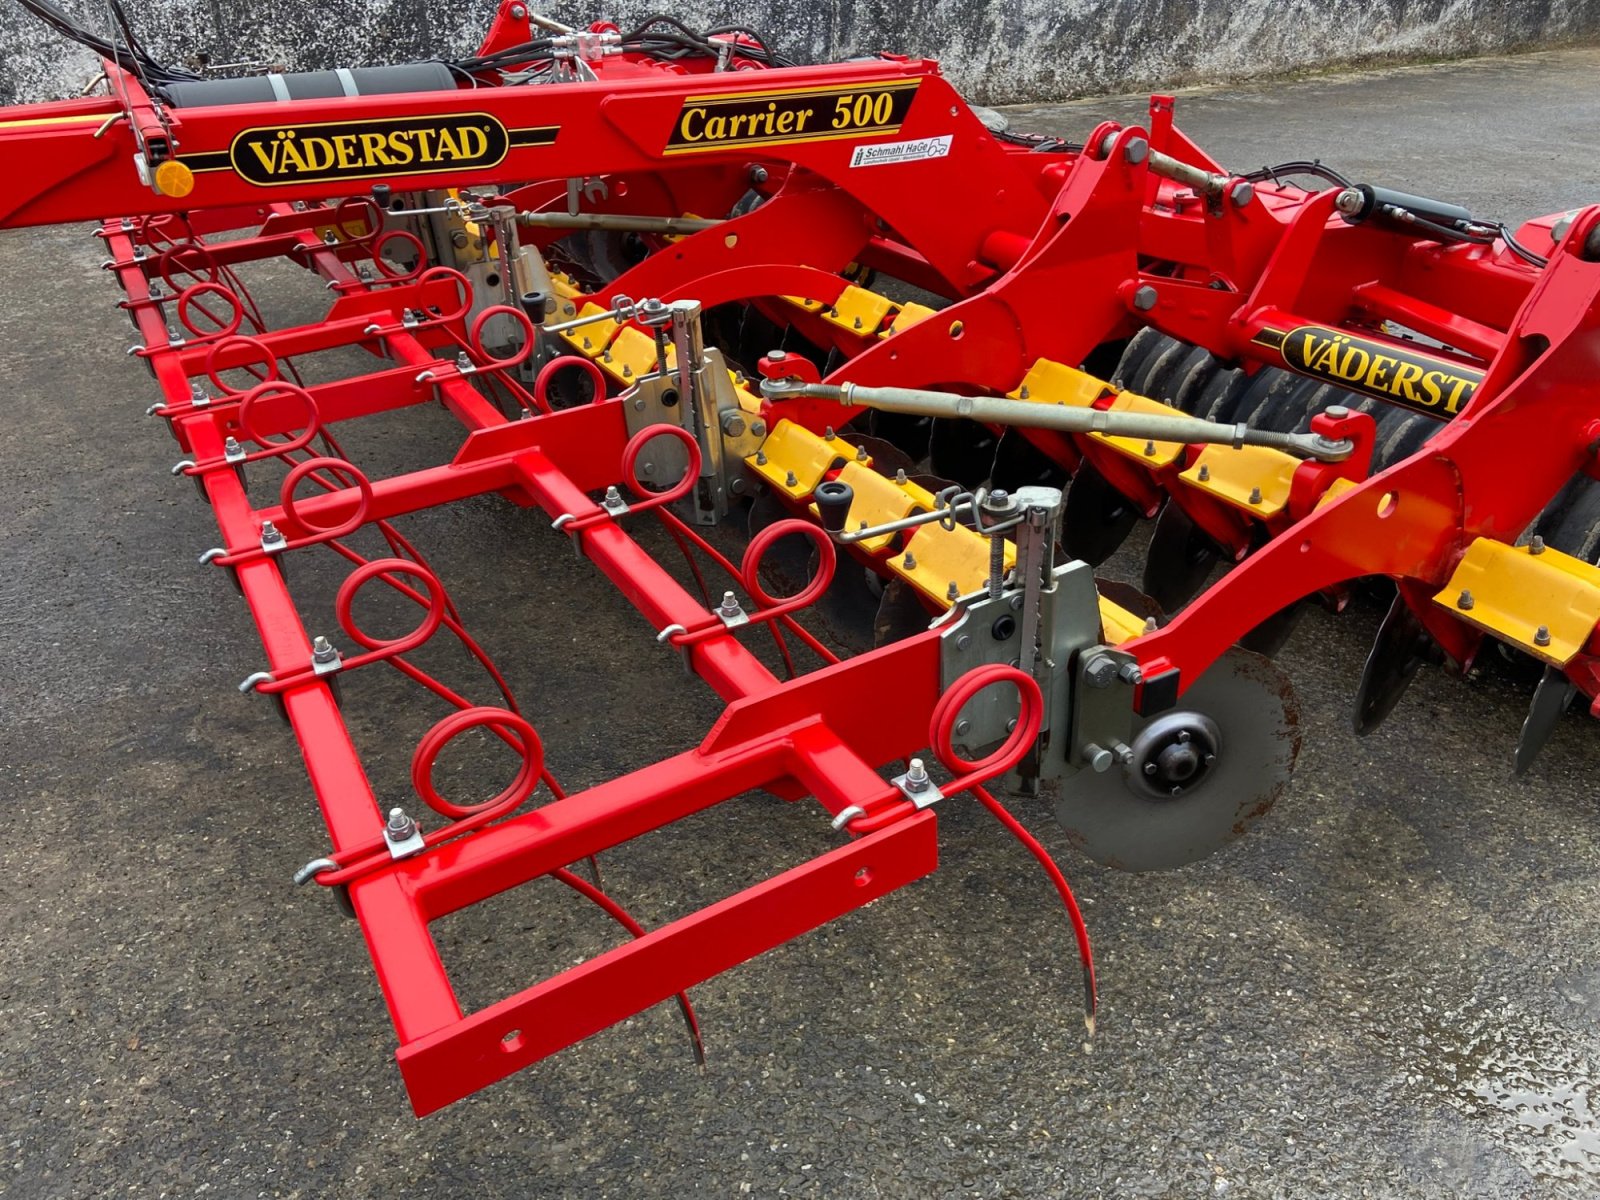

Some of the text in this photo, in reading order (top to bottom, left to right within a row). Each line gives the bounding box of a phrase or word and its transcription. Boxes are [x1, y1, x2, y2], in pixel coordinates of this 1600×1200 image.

[680, 92, 894, 142] Carrier 500
[248, 126, 488, 175] VÄDERSTAD
[865, 141, 928, 158] Schmahl HaGe
